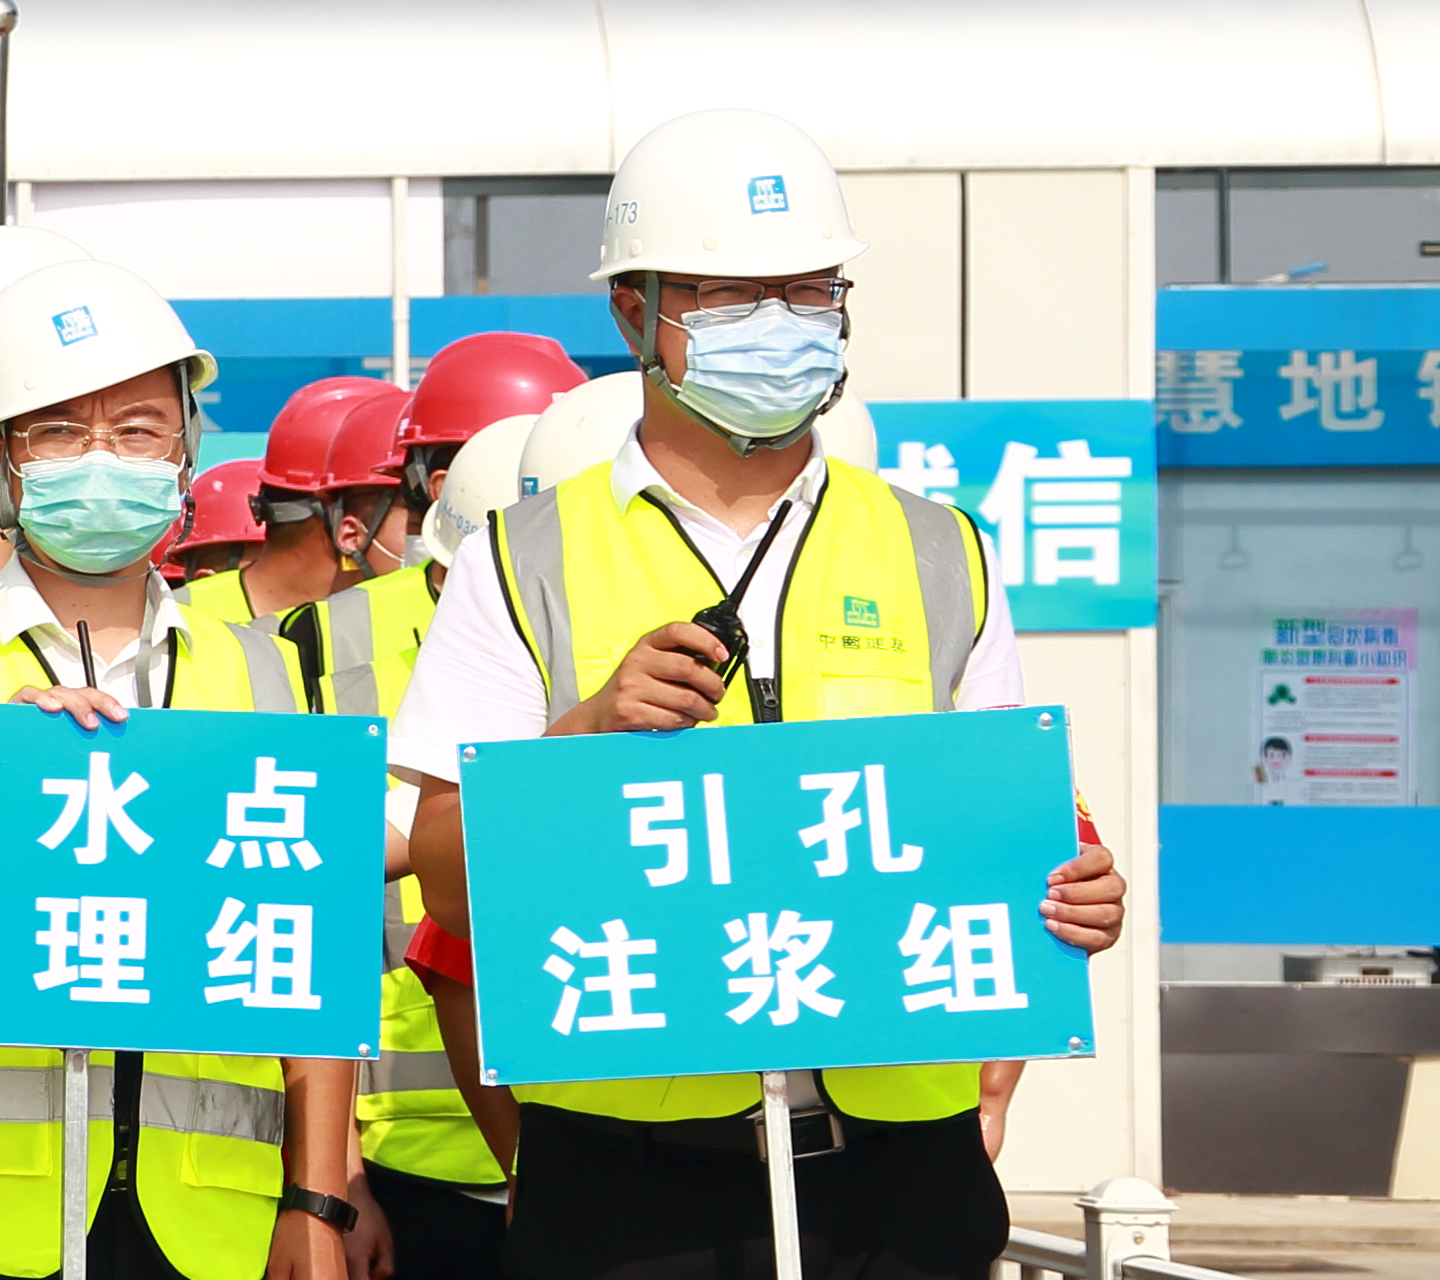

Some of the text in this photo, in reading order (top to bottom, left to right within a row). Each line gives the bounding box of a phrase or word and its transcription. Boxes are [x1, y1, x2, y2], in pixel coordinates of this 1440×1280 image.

[622, 764, 924, 887] 引孔
[542, 902, 1029, 1037] 注浆组
